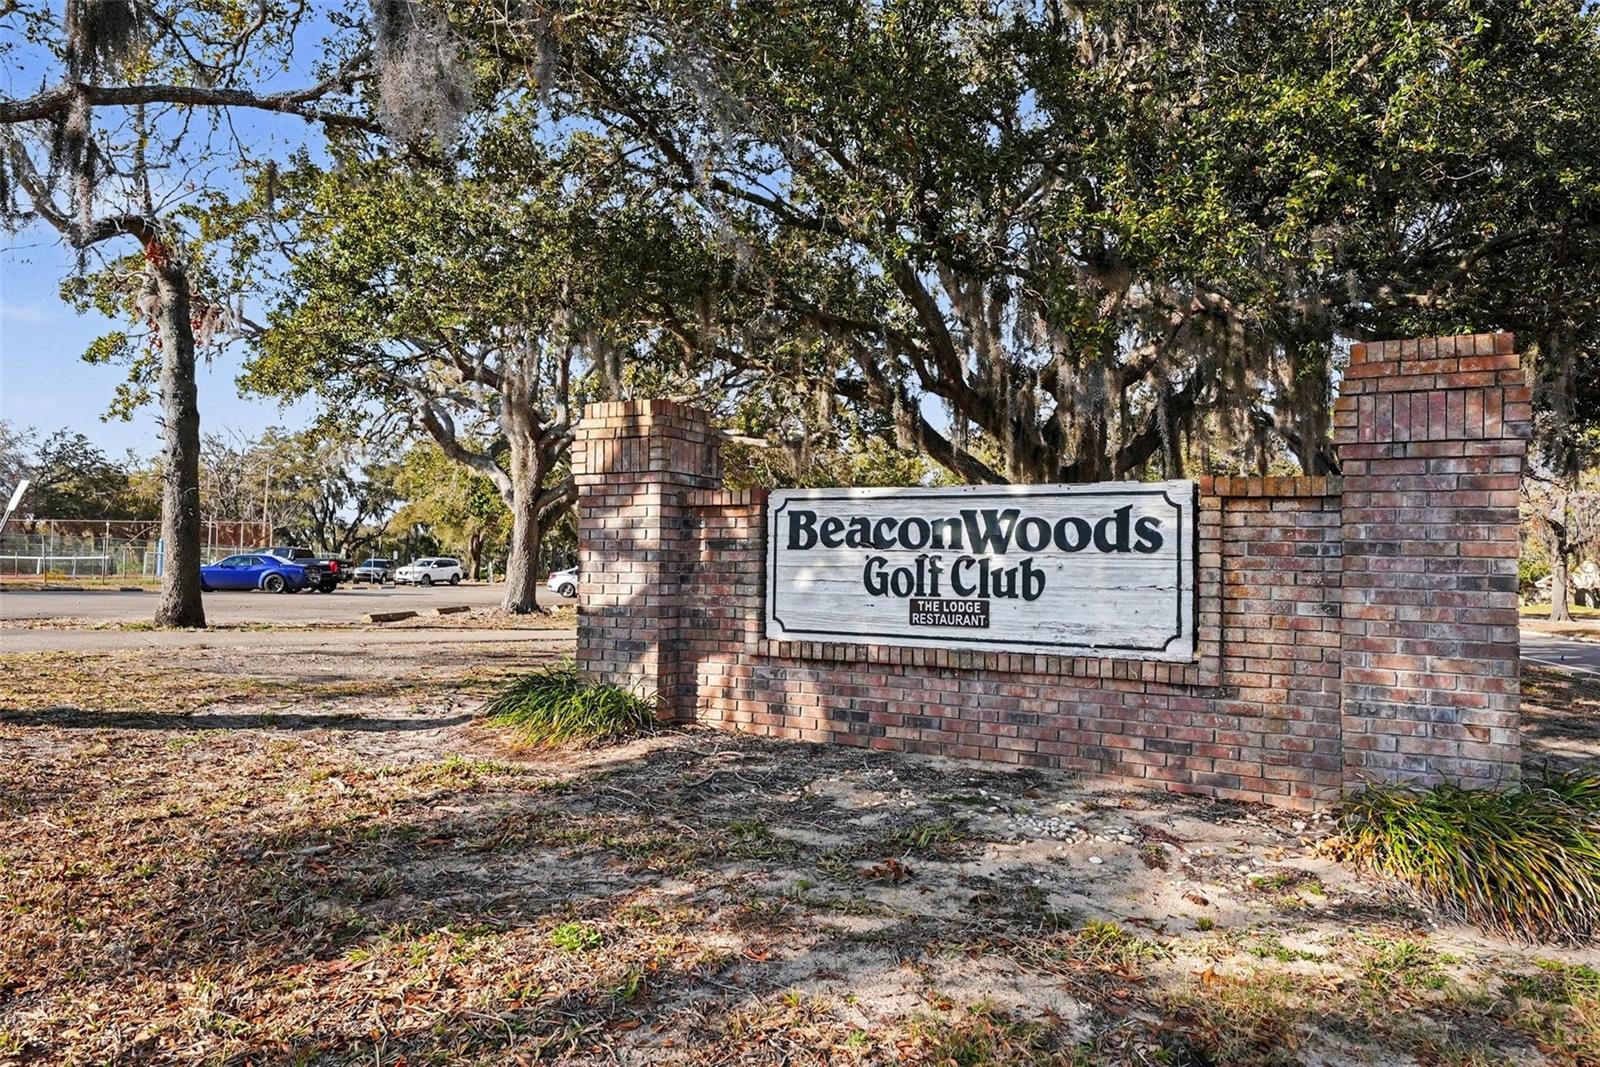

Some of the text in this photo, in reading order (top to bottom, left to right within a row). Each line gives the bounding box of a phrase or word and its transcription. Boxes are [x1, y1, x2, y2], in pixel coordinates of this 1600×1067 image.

[787, 504, 1164, 554] BeaconWoods
[864, 554, 1046, 601] Golf Club
[912, 613, 986, 626] RESTAURANT
[917, 601, 981, 613] THE LODGE
